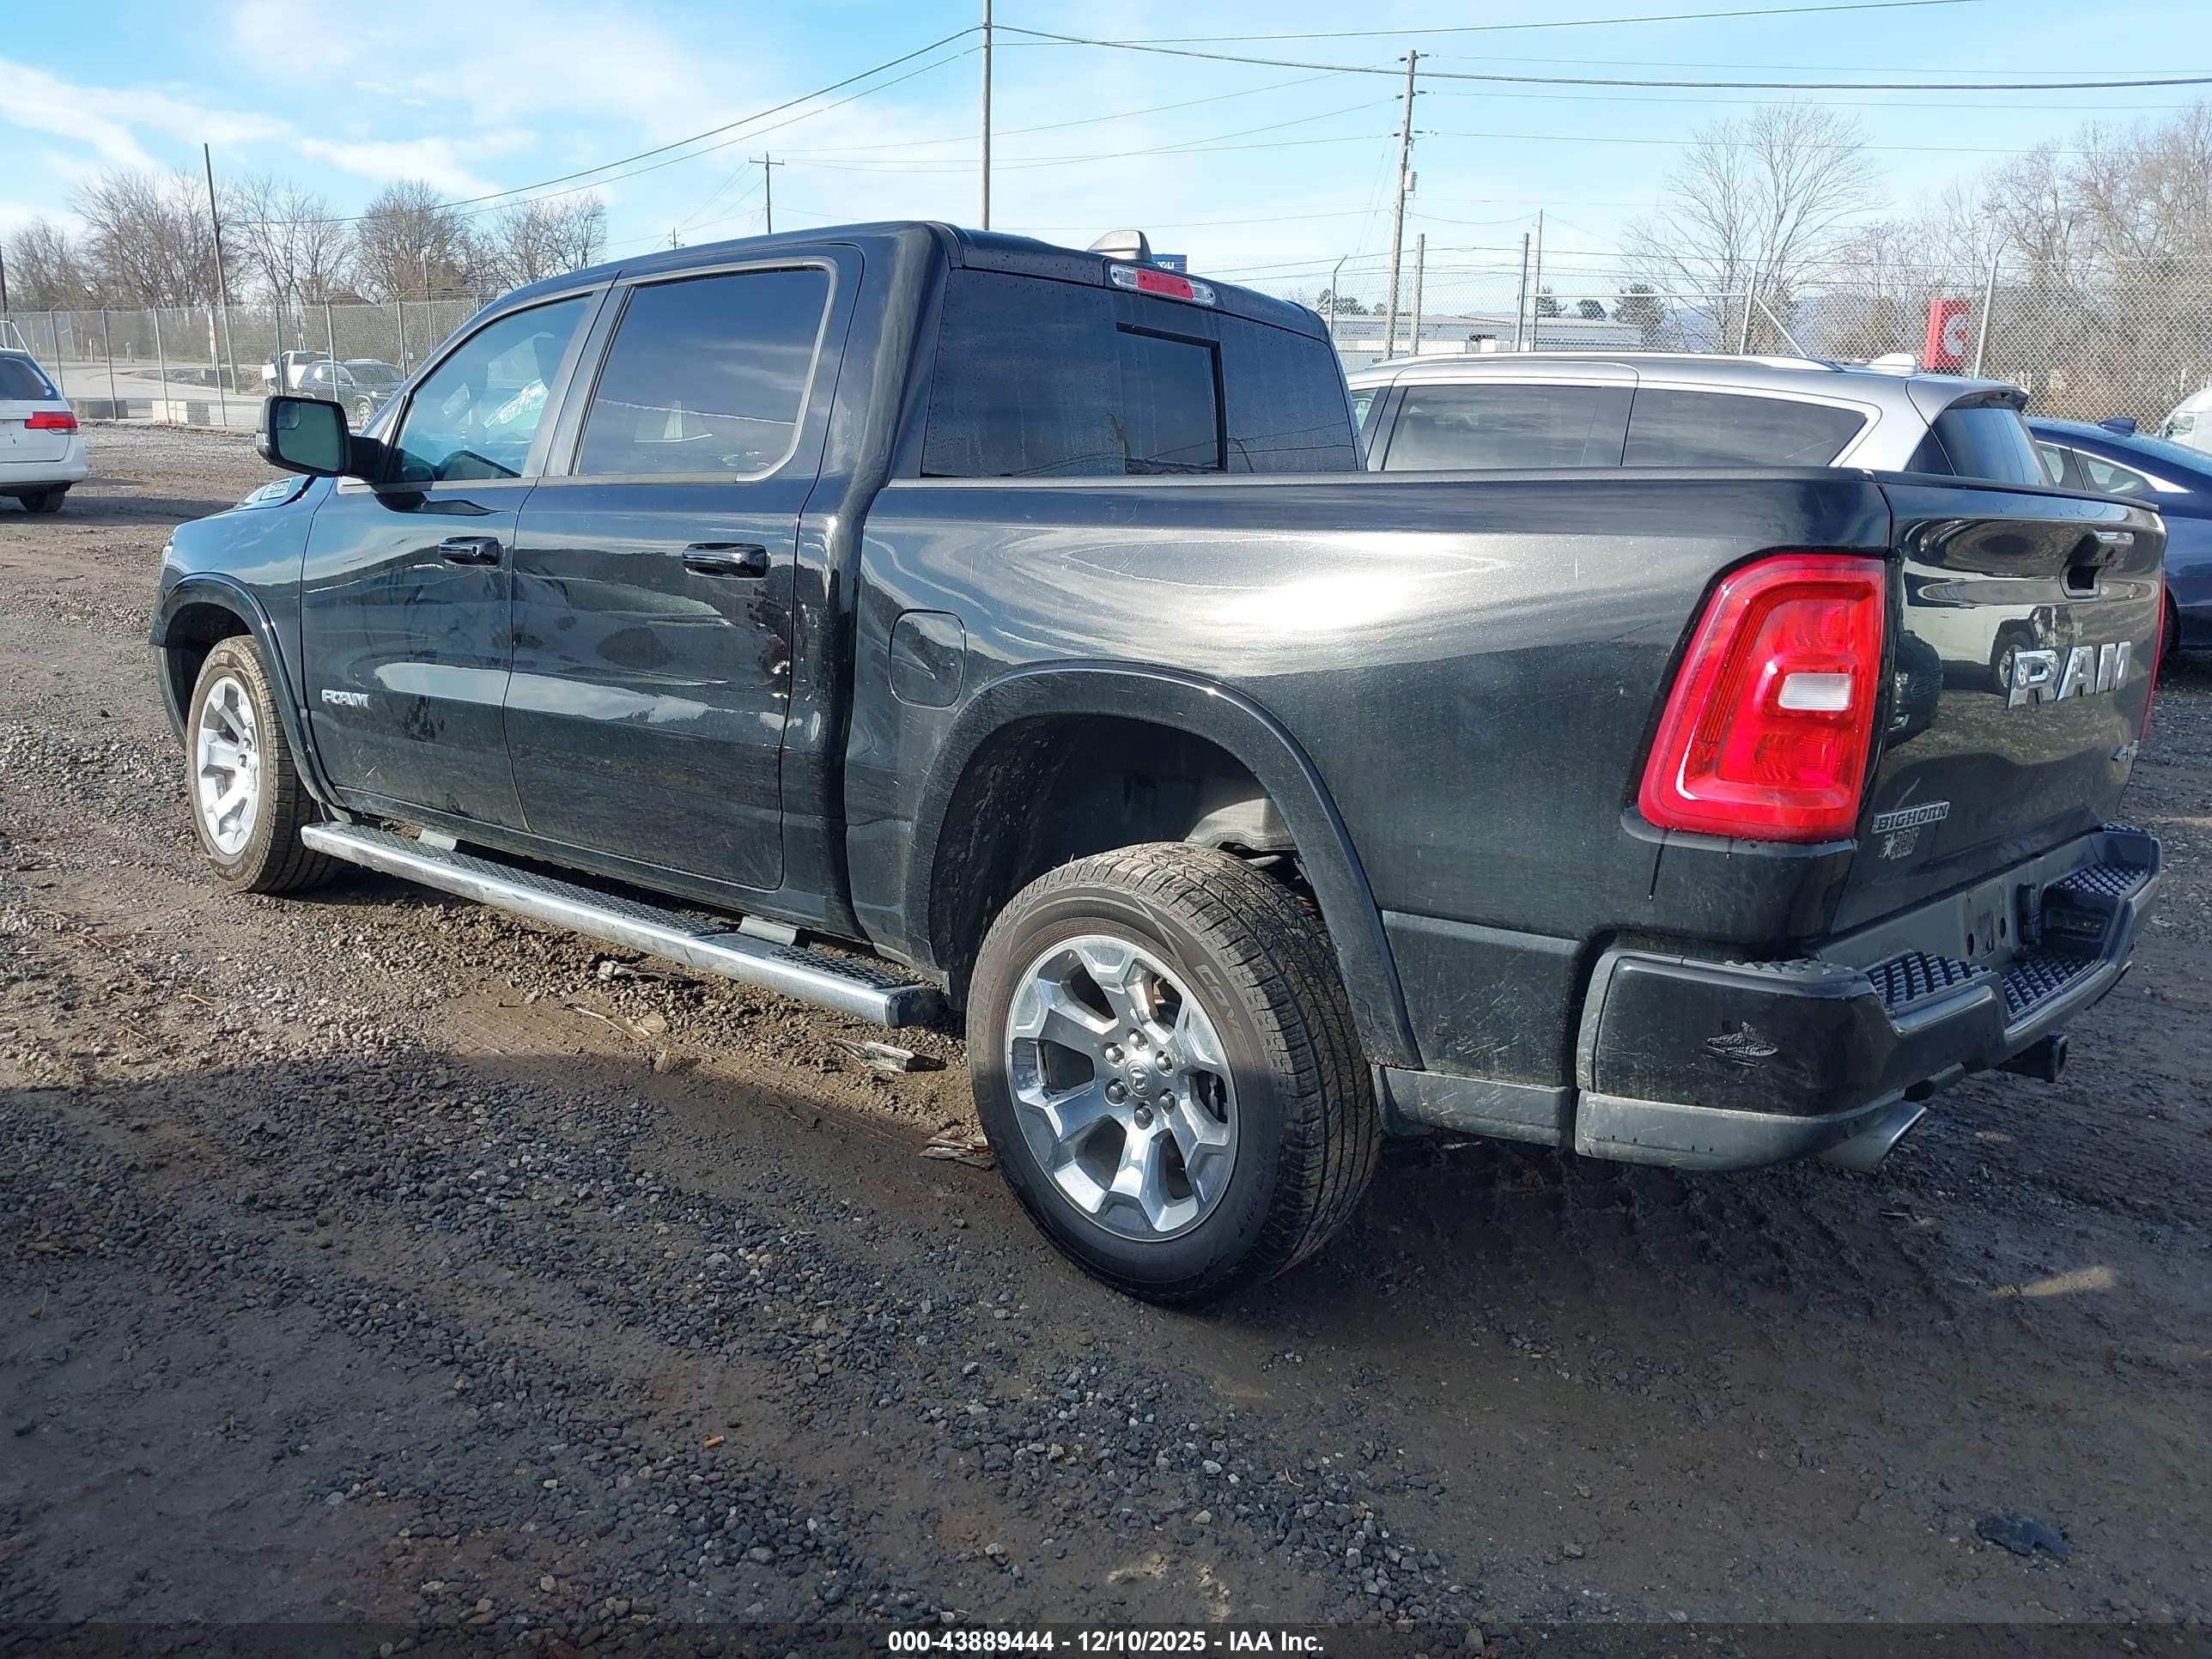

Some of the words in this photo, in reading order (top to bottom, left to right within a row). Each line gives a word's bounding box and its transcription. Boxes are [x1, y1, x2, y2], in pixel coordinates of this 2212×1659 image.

[2007, 641, 2132, 709] RAM
[321, 689, 371, 708] RAM
[1873, 801, 1950, 833] BIGHORN
